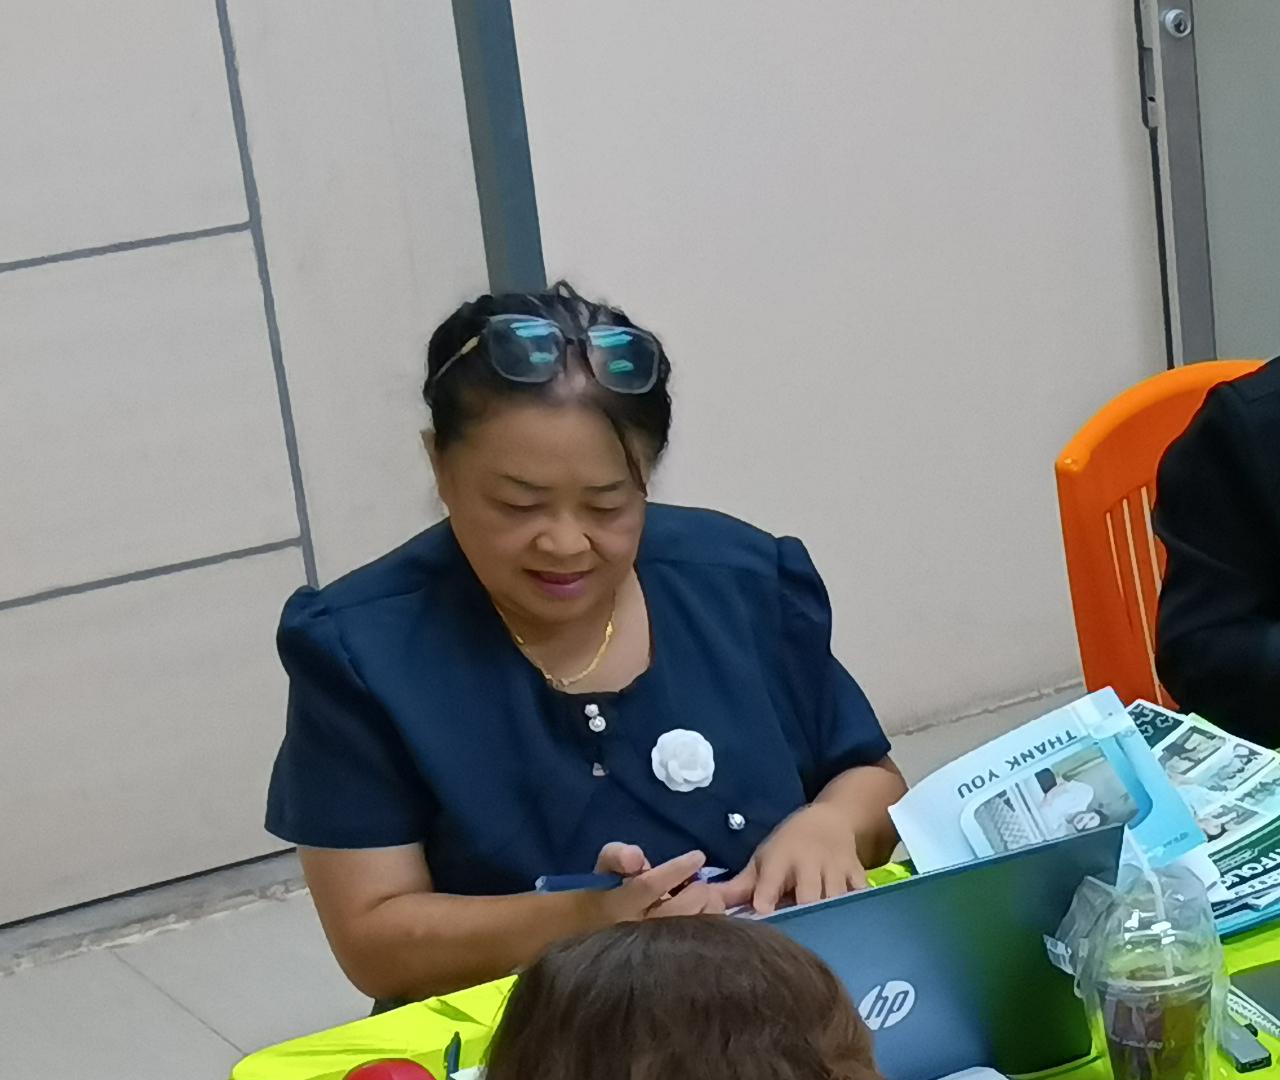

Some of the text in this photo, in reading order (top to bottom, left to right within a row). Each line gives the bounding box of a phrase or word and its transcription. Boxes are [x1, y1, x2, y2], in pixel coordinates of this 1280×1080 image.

[956, 730, 1078, 799] THANK YOU
[861, 981, 913, 1029] hp
